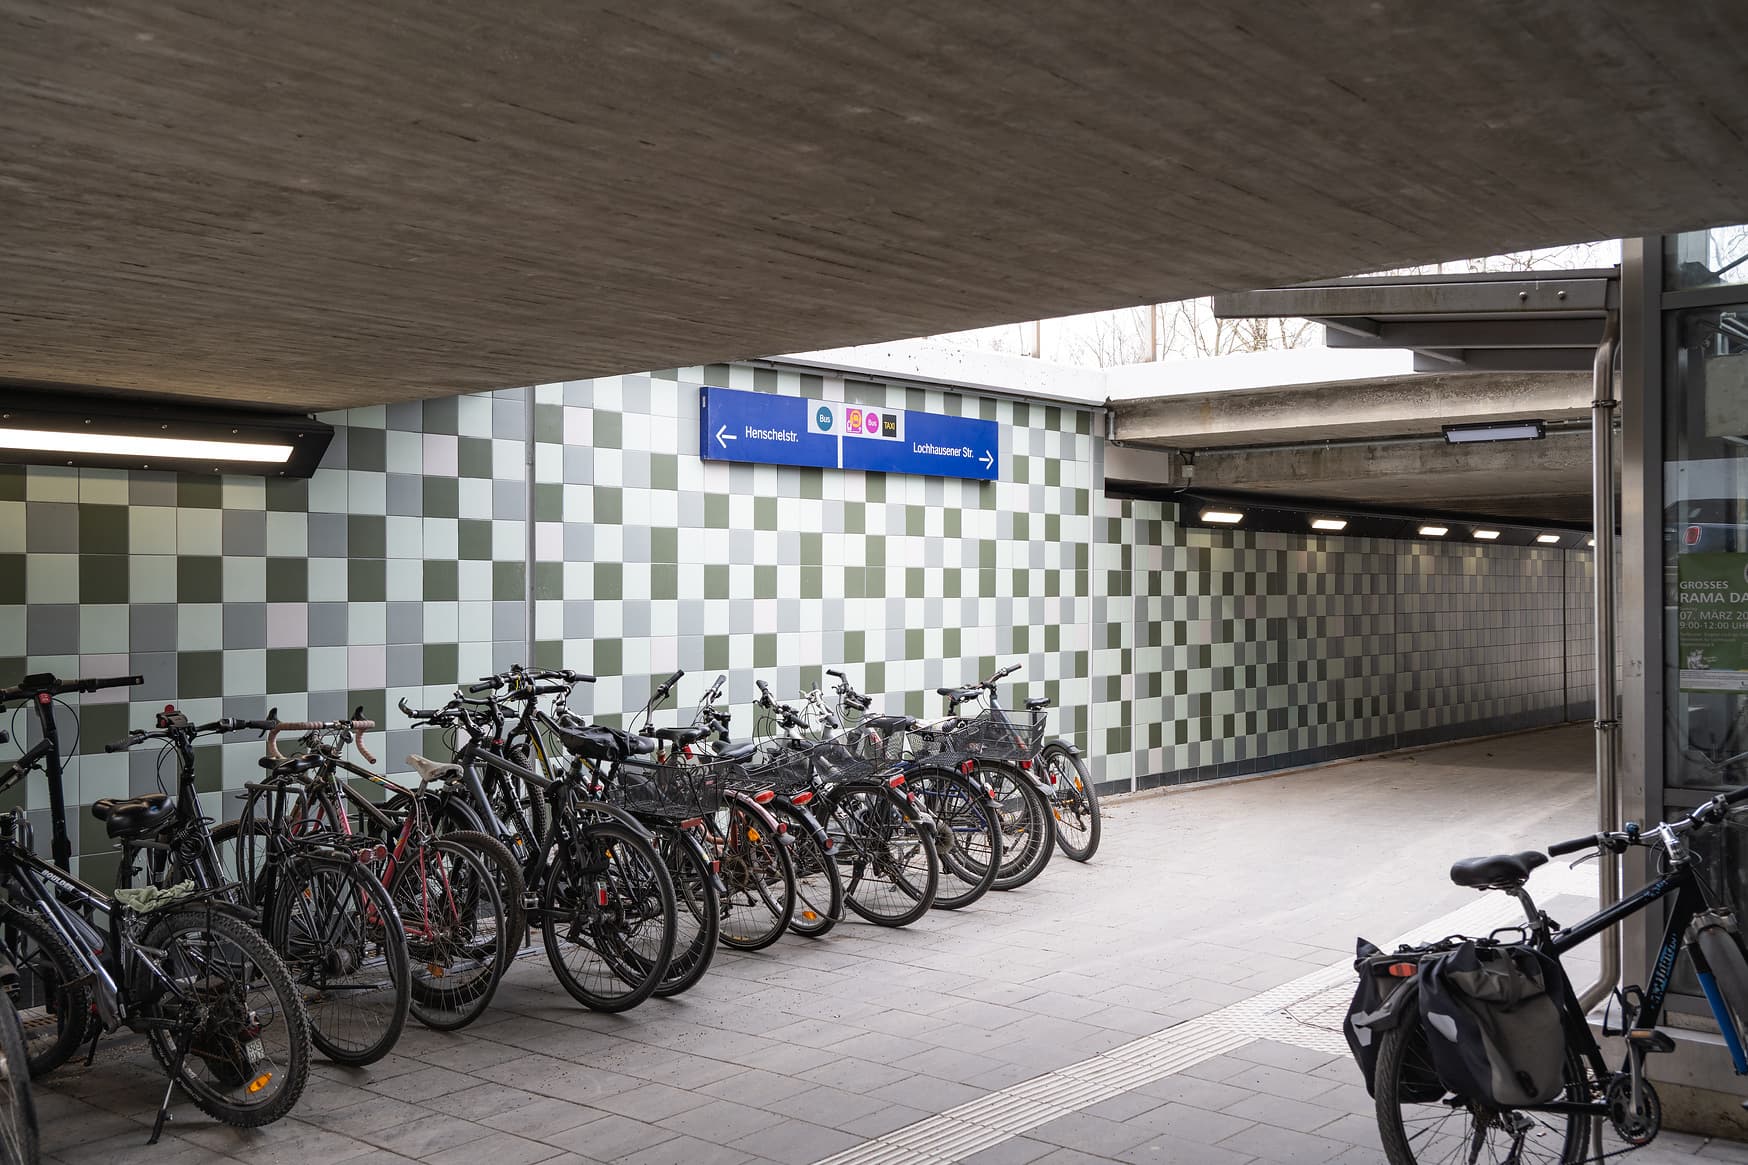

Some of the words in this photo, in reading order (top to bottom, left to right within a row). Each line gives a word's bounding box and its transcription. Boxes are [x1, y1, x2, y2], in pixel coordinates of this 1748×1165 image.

[819, 415, 831, 424] Bus
[867, 419, 878, 428] Bus
[883, 421, 896, 431] TAXI
[745, 425, 799, 443] Henschelstr.
[913, 442, 961, 457] Lochhausener
[962, 446, 974, 458] Str.
[1679, 580, 1729, 590] GROSSES
[1680, 592, 1725, 603] RAMA
[41, 869, 76, 892] BOULDER
